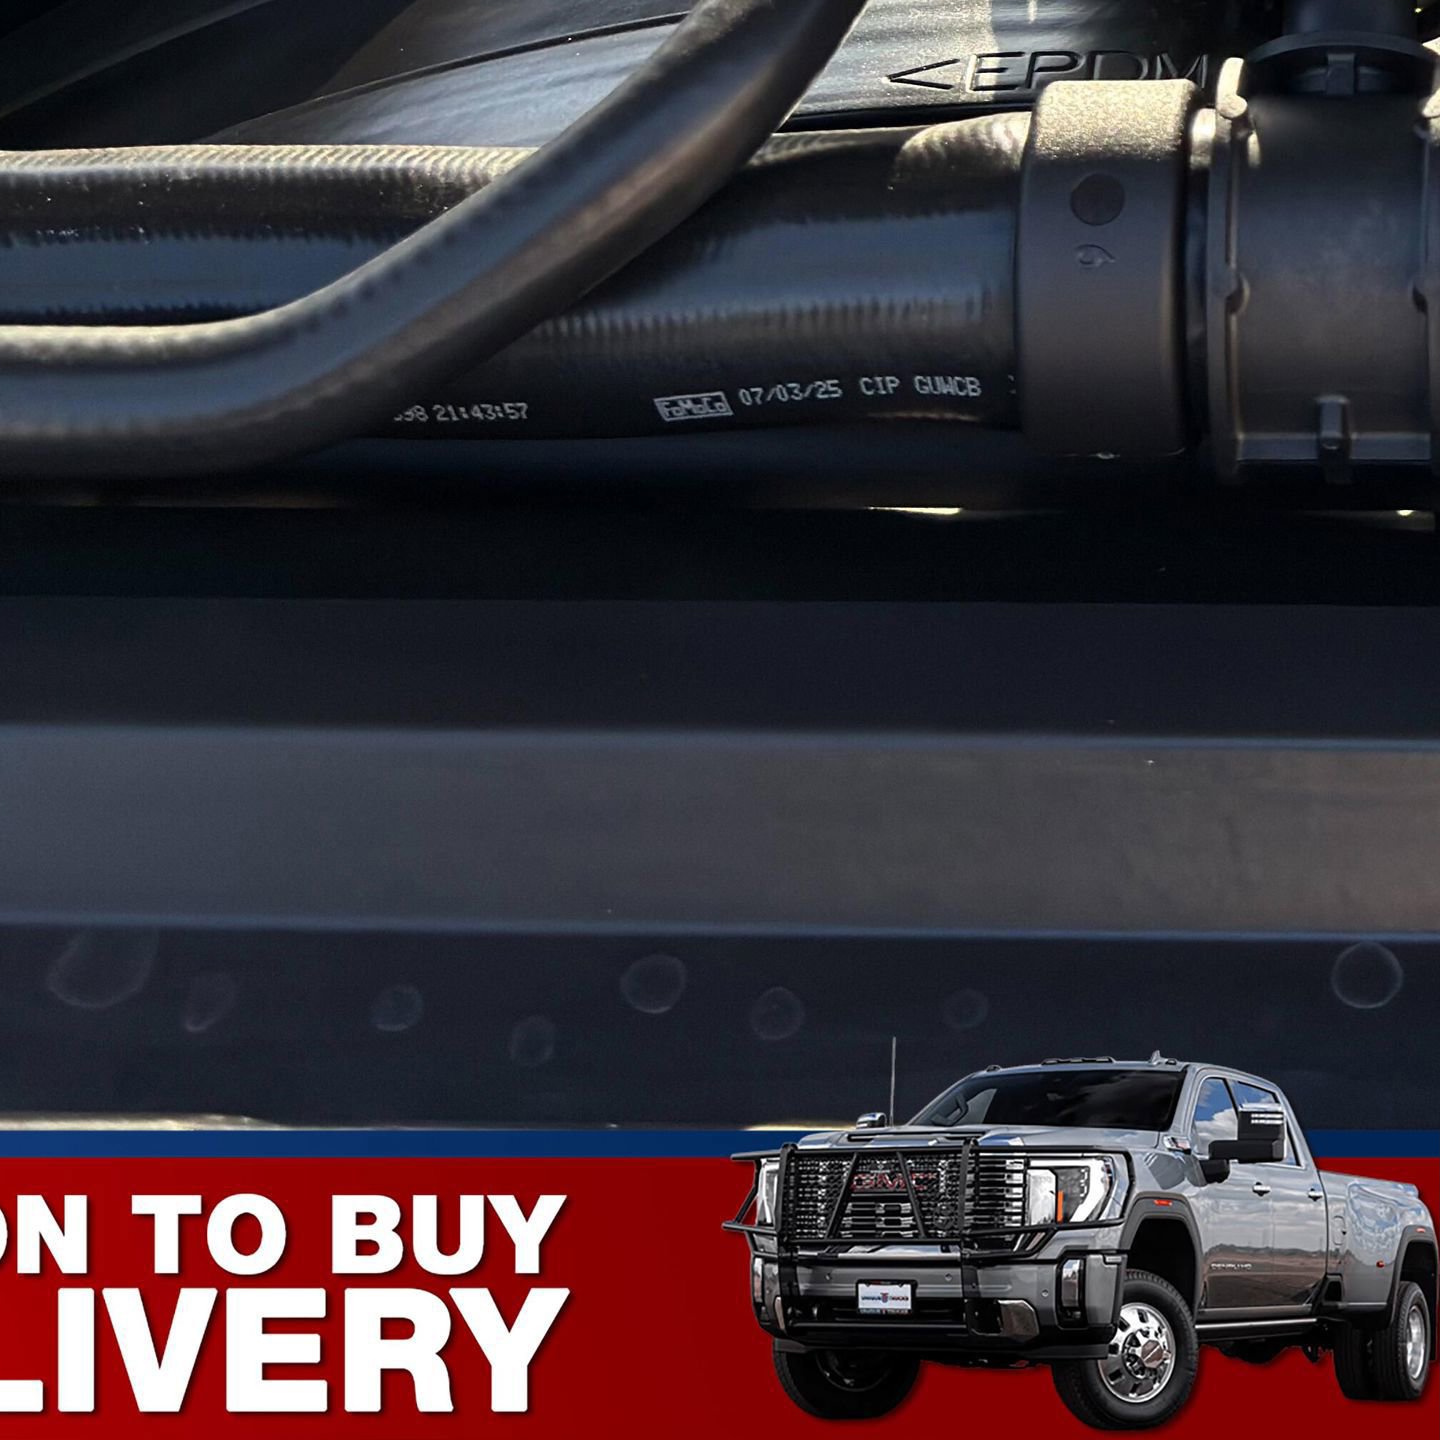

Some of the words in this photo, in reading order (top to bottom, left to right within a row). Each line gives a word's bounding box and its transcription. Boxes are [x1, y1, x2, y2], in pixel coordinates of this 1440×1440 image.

[433, 402, 529, 422] 21:43:57
[657, 395, 730, 421] FoMoCo
[738, 379, 844, 407] 07/03/25
[860, 375, 901, 397] CIP
